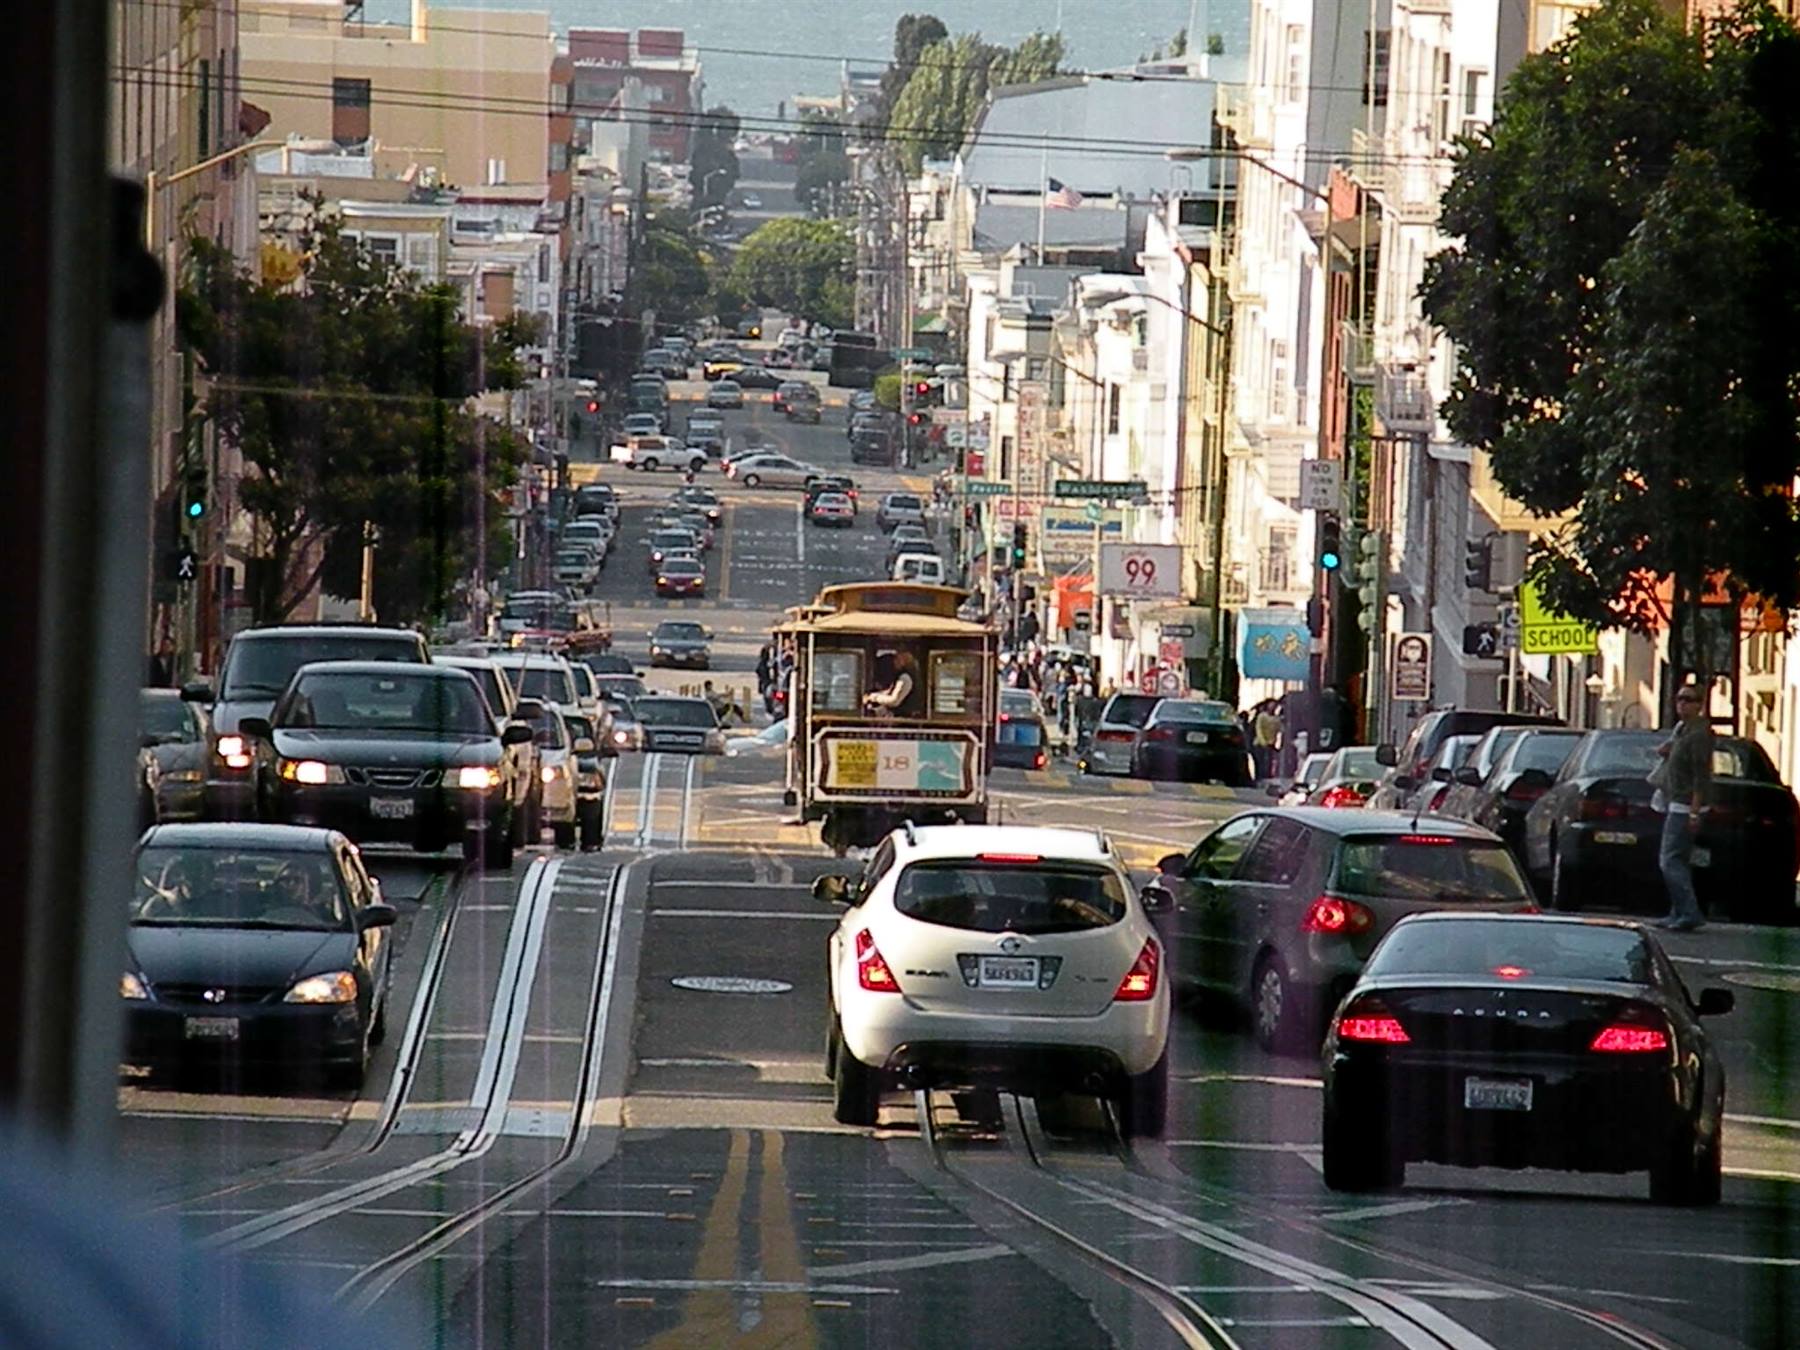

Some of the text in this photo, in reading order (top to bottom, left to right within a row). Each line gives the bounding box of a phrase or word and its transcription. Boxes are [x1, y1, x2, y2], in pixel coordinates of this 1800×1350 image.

[1311, 463, 1330, 474] NO
[1312, 487, 1327, 495] ON
[1126, 559, 1155, 585] 99
[1528, 628, 1594, 646] SCHOOL
[883, 755, 910, 771] 18
[1453, 1008, 1550, 1018] ACURA
